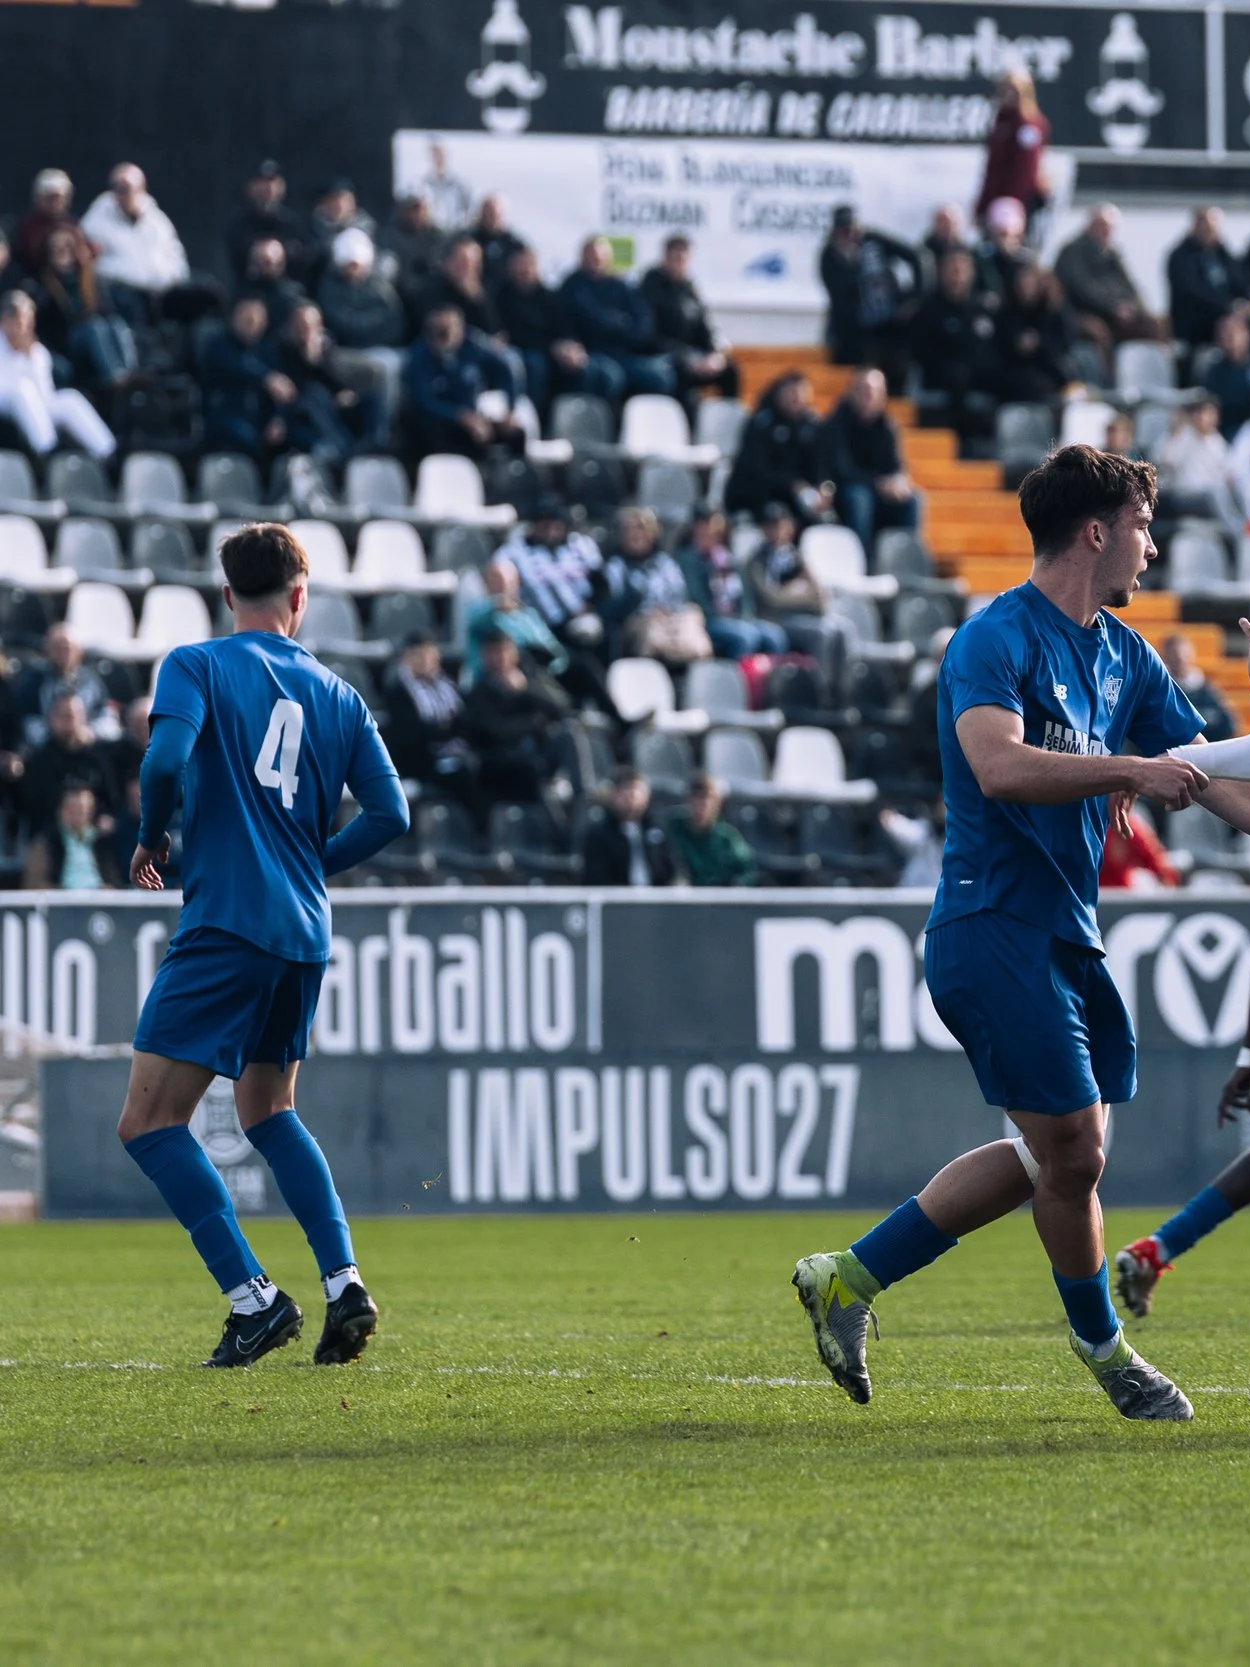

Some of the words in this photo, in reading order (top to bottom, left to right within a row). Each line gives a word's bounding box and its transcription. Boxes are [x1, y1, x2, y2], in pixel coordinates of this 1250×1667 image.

[562, 4, 867, 78] Moustache
[874, 13, 1072, 82] Barber
[776, 91, 822, 137] DE
[825, 91, 997, 140] CABALLER
[254, 698, 304, 810] 4
[314, 905, 577, 1055] arballo
